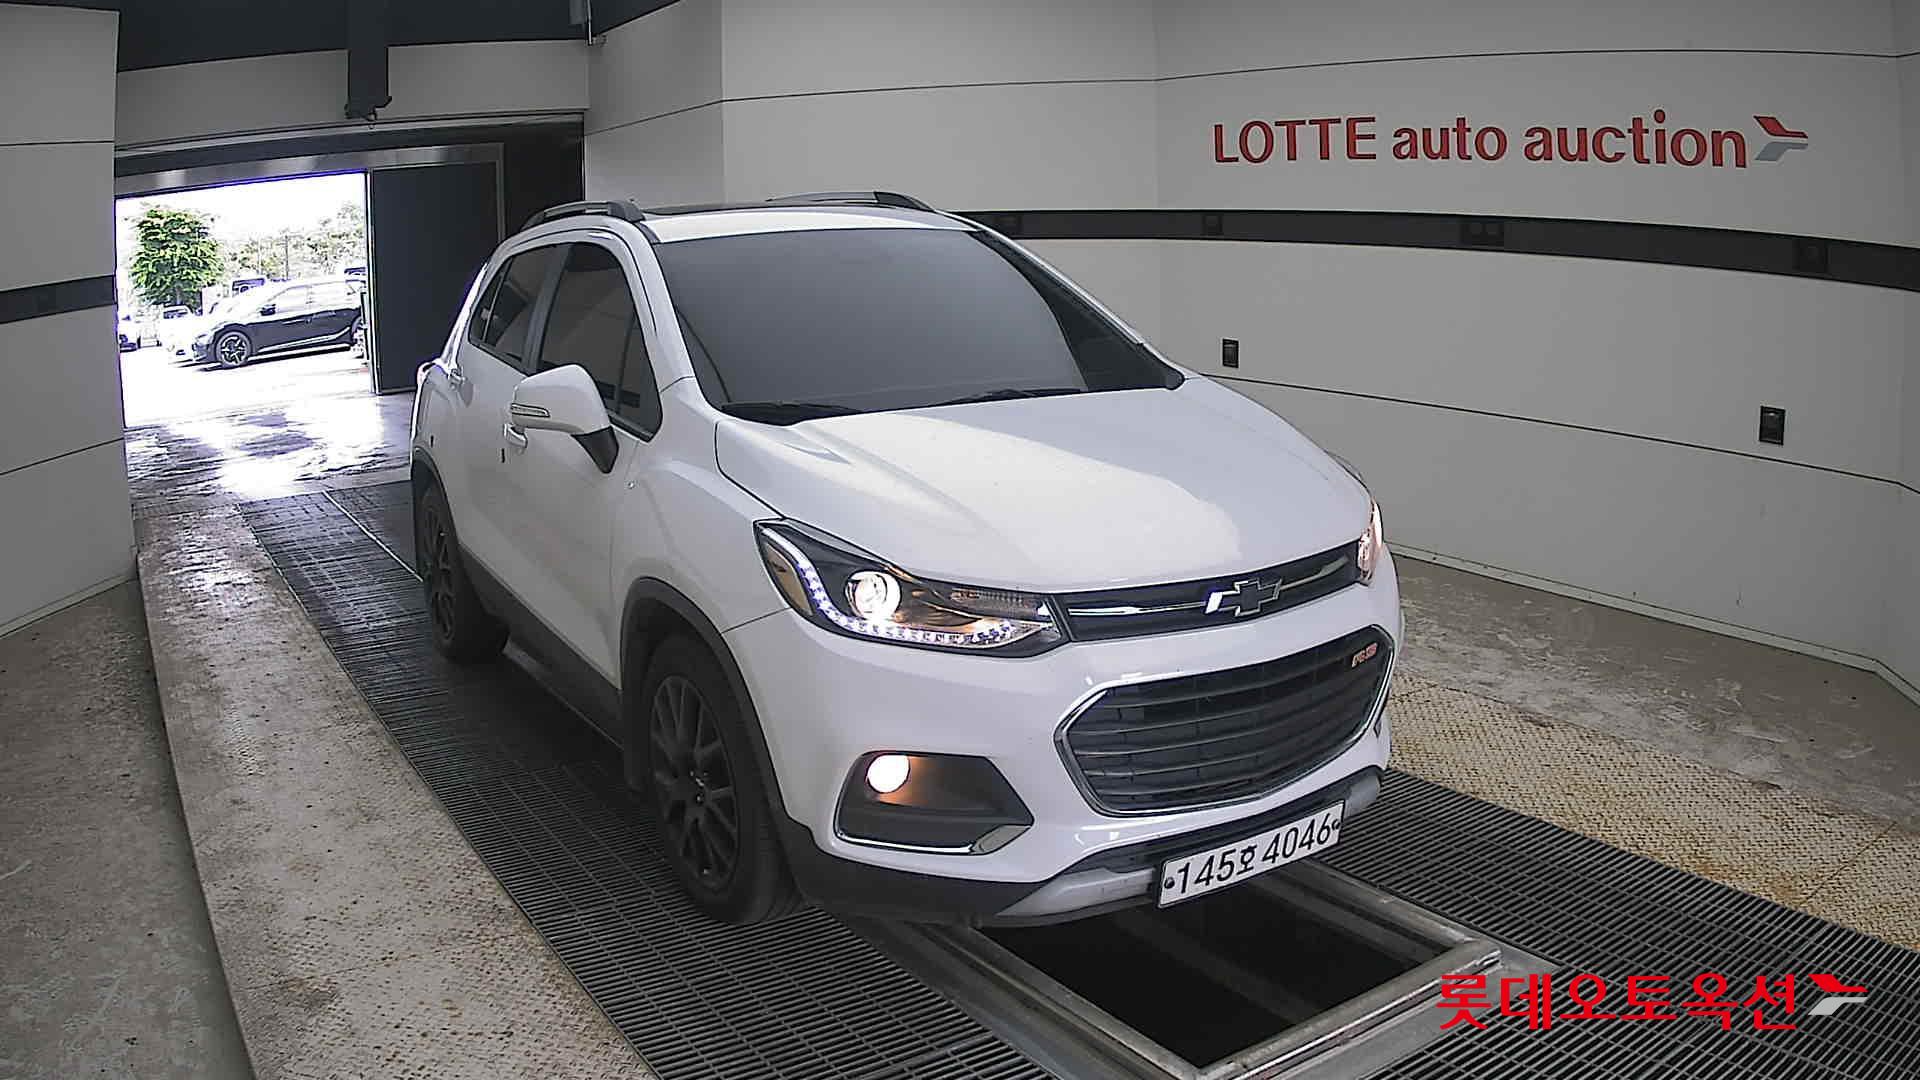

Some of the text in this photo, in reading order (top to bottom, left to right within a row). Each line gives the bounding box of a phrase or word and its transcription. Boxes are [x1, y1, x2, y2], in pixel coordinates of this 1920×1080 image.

[1213, 109, 1748, 168] LOTTE auto auction
[1176, 812, 1331, 894] 145호 4046
